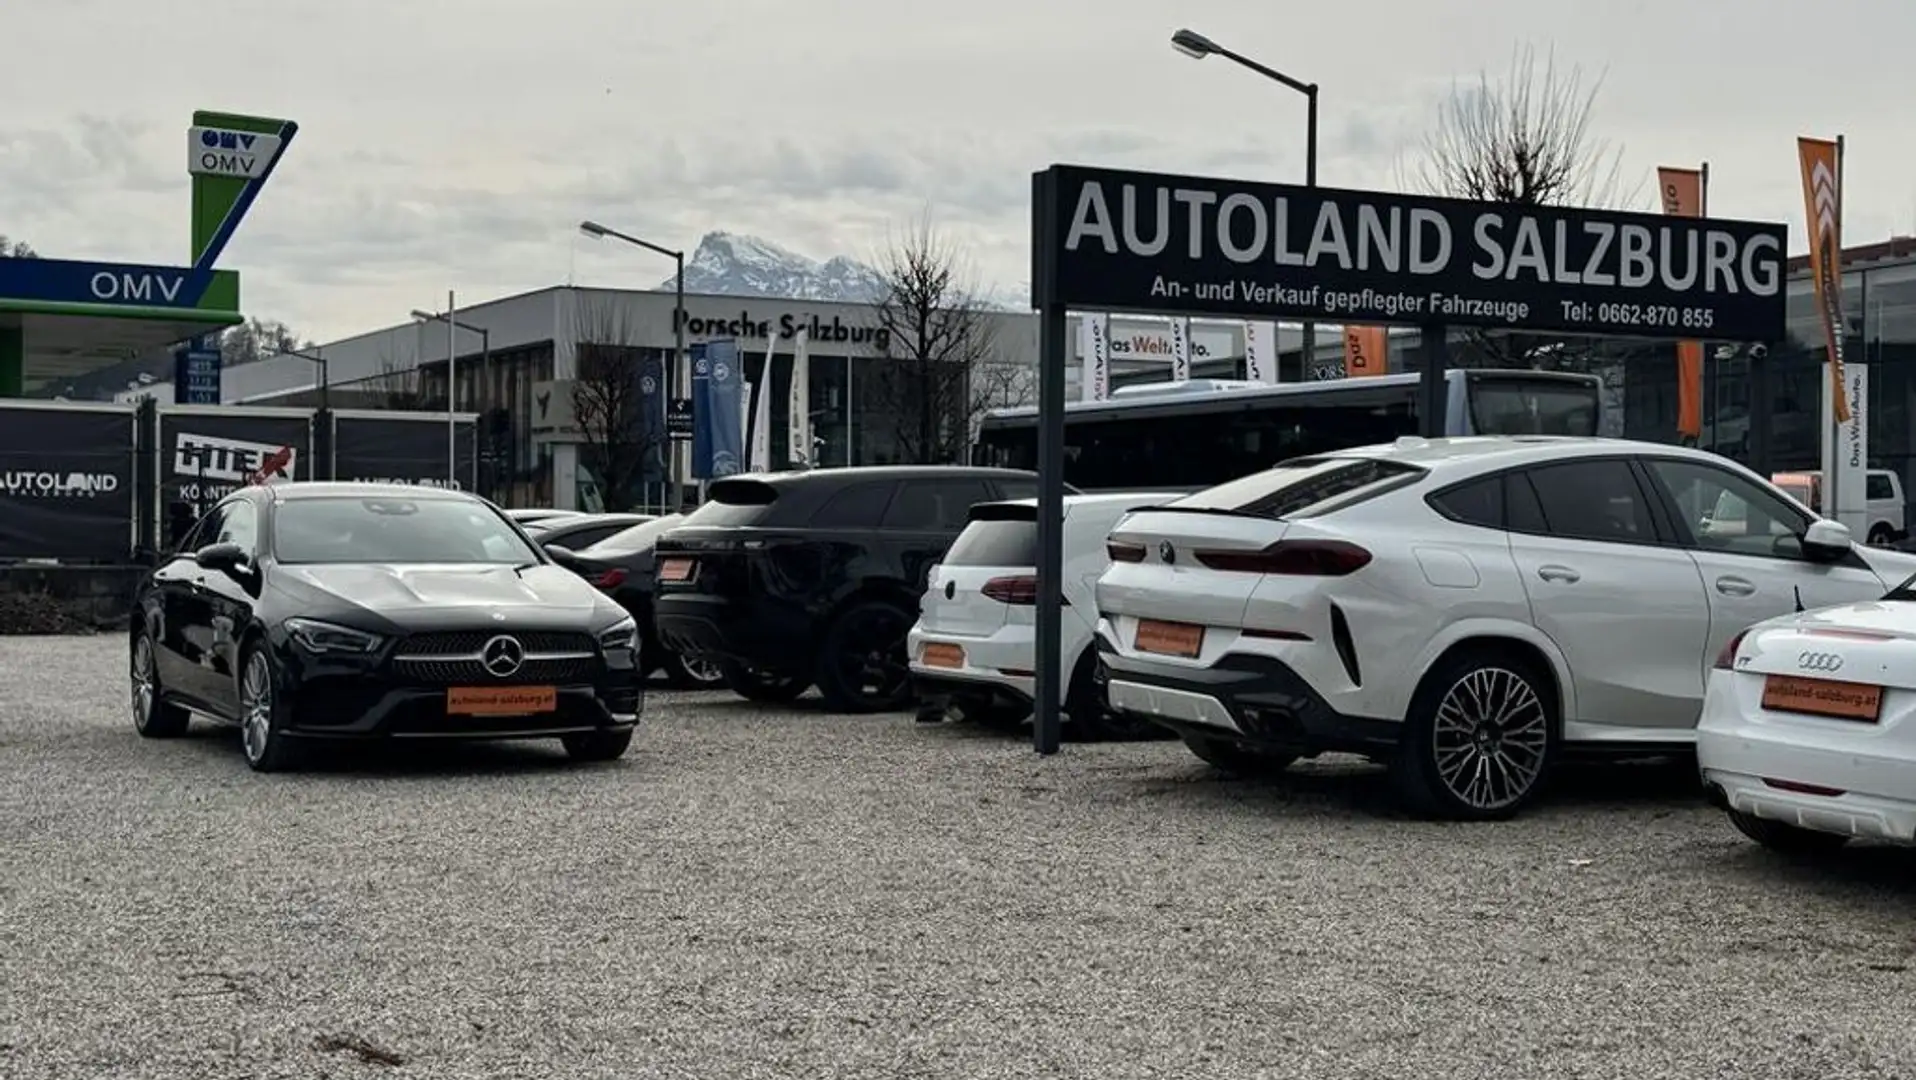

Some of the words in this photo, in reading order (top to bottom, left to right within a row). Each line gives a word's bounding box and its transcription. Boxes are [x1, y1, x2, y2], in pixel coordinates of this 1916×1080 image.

[201, 152, 255, 174] OMV
[1065, 181, 1453, 274] AUTOLAND
[1471, 212, 1781, 296] SALZBURG
[91, 272, 184, 301] OMV
[1150, 276, 1189, 298] An-
[1195, 280, 1234, 301] und
[1242, 281, 1320, 306] Verkauf
[1324, 288, 1423, 315] gepflegter
[1429, 293, 1529, 323] Fahrzeuge
[673, 308, 769, 338] Porsche
[1561, 300, 1593, 322] Tel:
[1598, 302, 1678, 326] 0662-870
[1682, 307, 1713, 328] 855
[1110, 340, 1131, 353] as
[1132, 336, 1210, 357] Weltto.
[1850, 442, 1860, 468] Das
